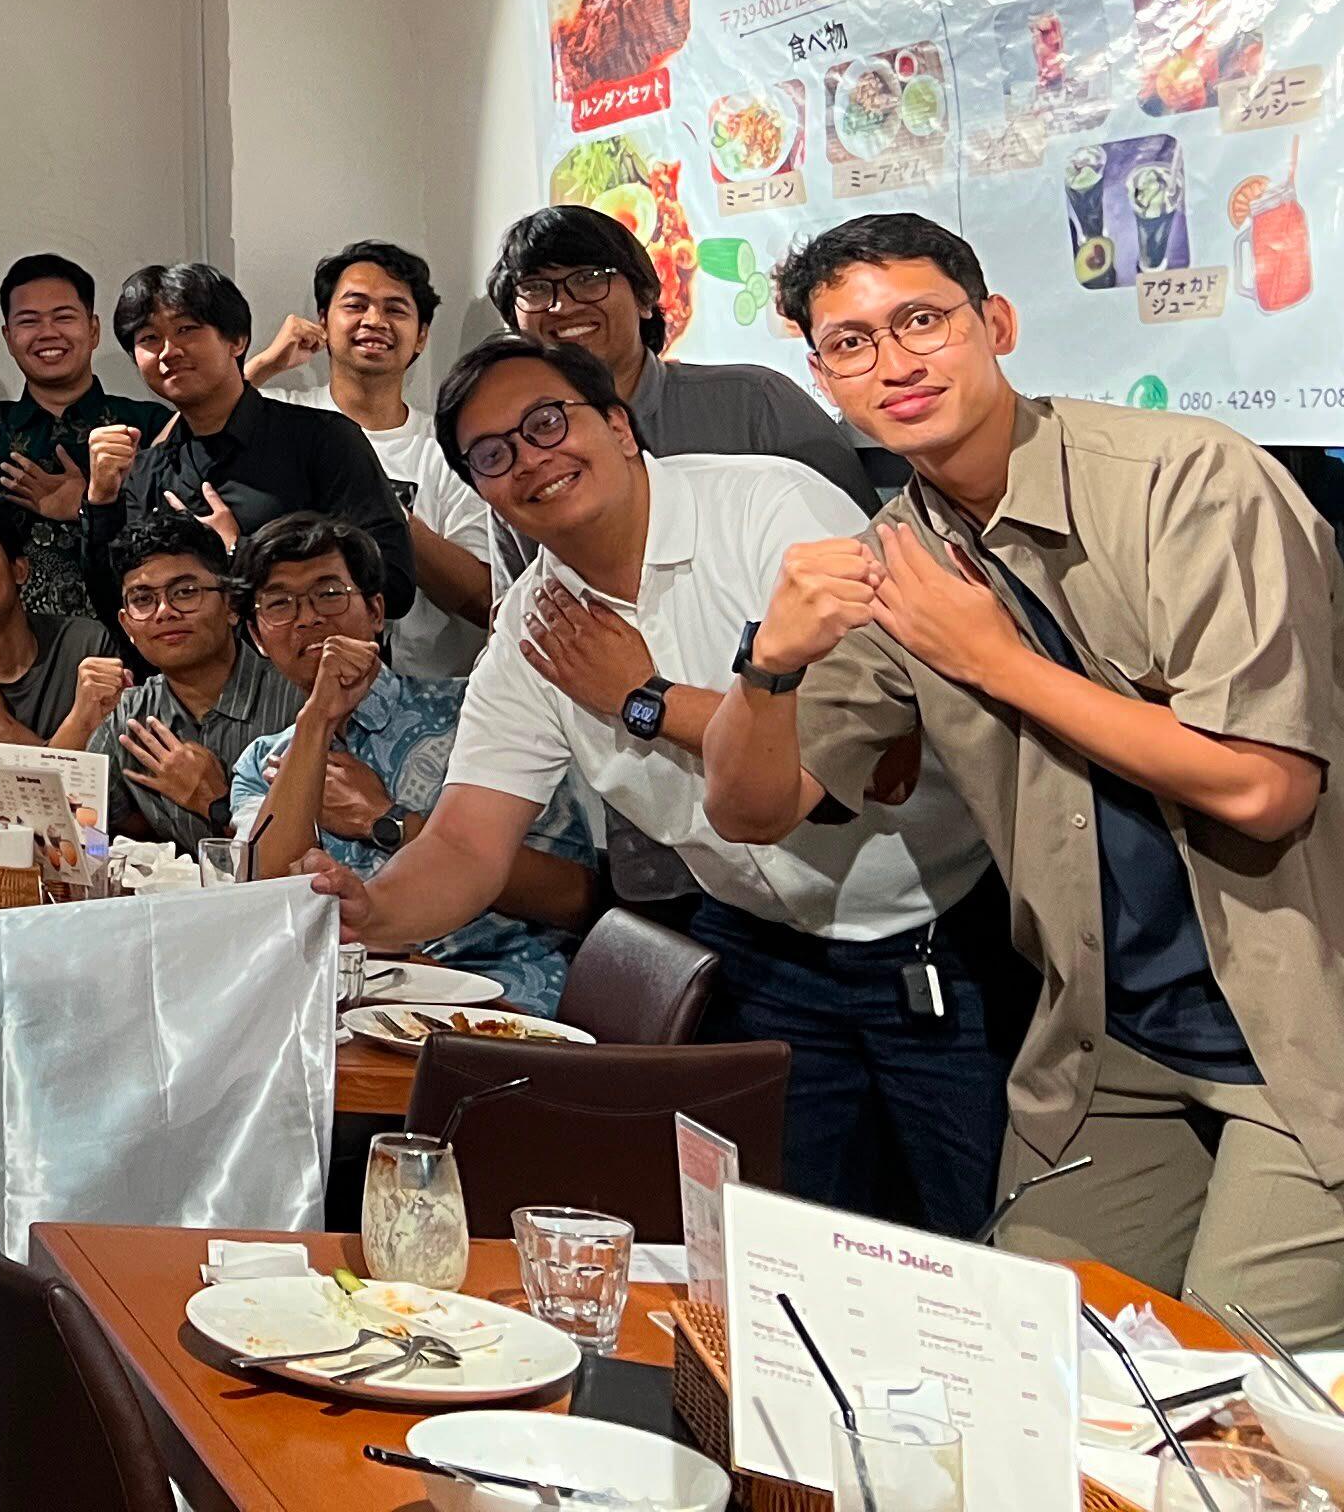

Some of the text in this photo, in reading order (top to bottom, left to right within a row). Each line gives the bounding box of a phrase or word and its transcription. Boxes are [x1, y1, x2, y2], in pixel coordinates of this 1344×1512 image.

[787, 19, 849, 63] 食べ物
[578, 79, 664, 119] ルンダンセット
[724, 180, 795, 206] ミーゴレン
[1142, 274, 1219, 297] アヴォカド
[1152, 296, 1210, 315] ジュース
[1180, 392, 1212, 411] 080
[1227, 389, 1276, 410] 4249
[1298, 387, 1344, 409] 1708
[833, 1232, 954, 1278] Fresh Juice
